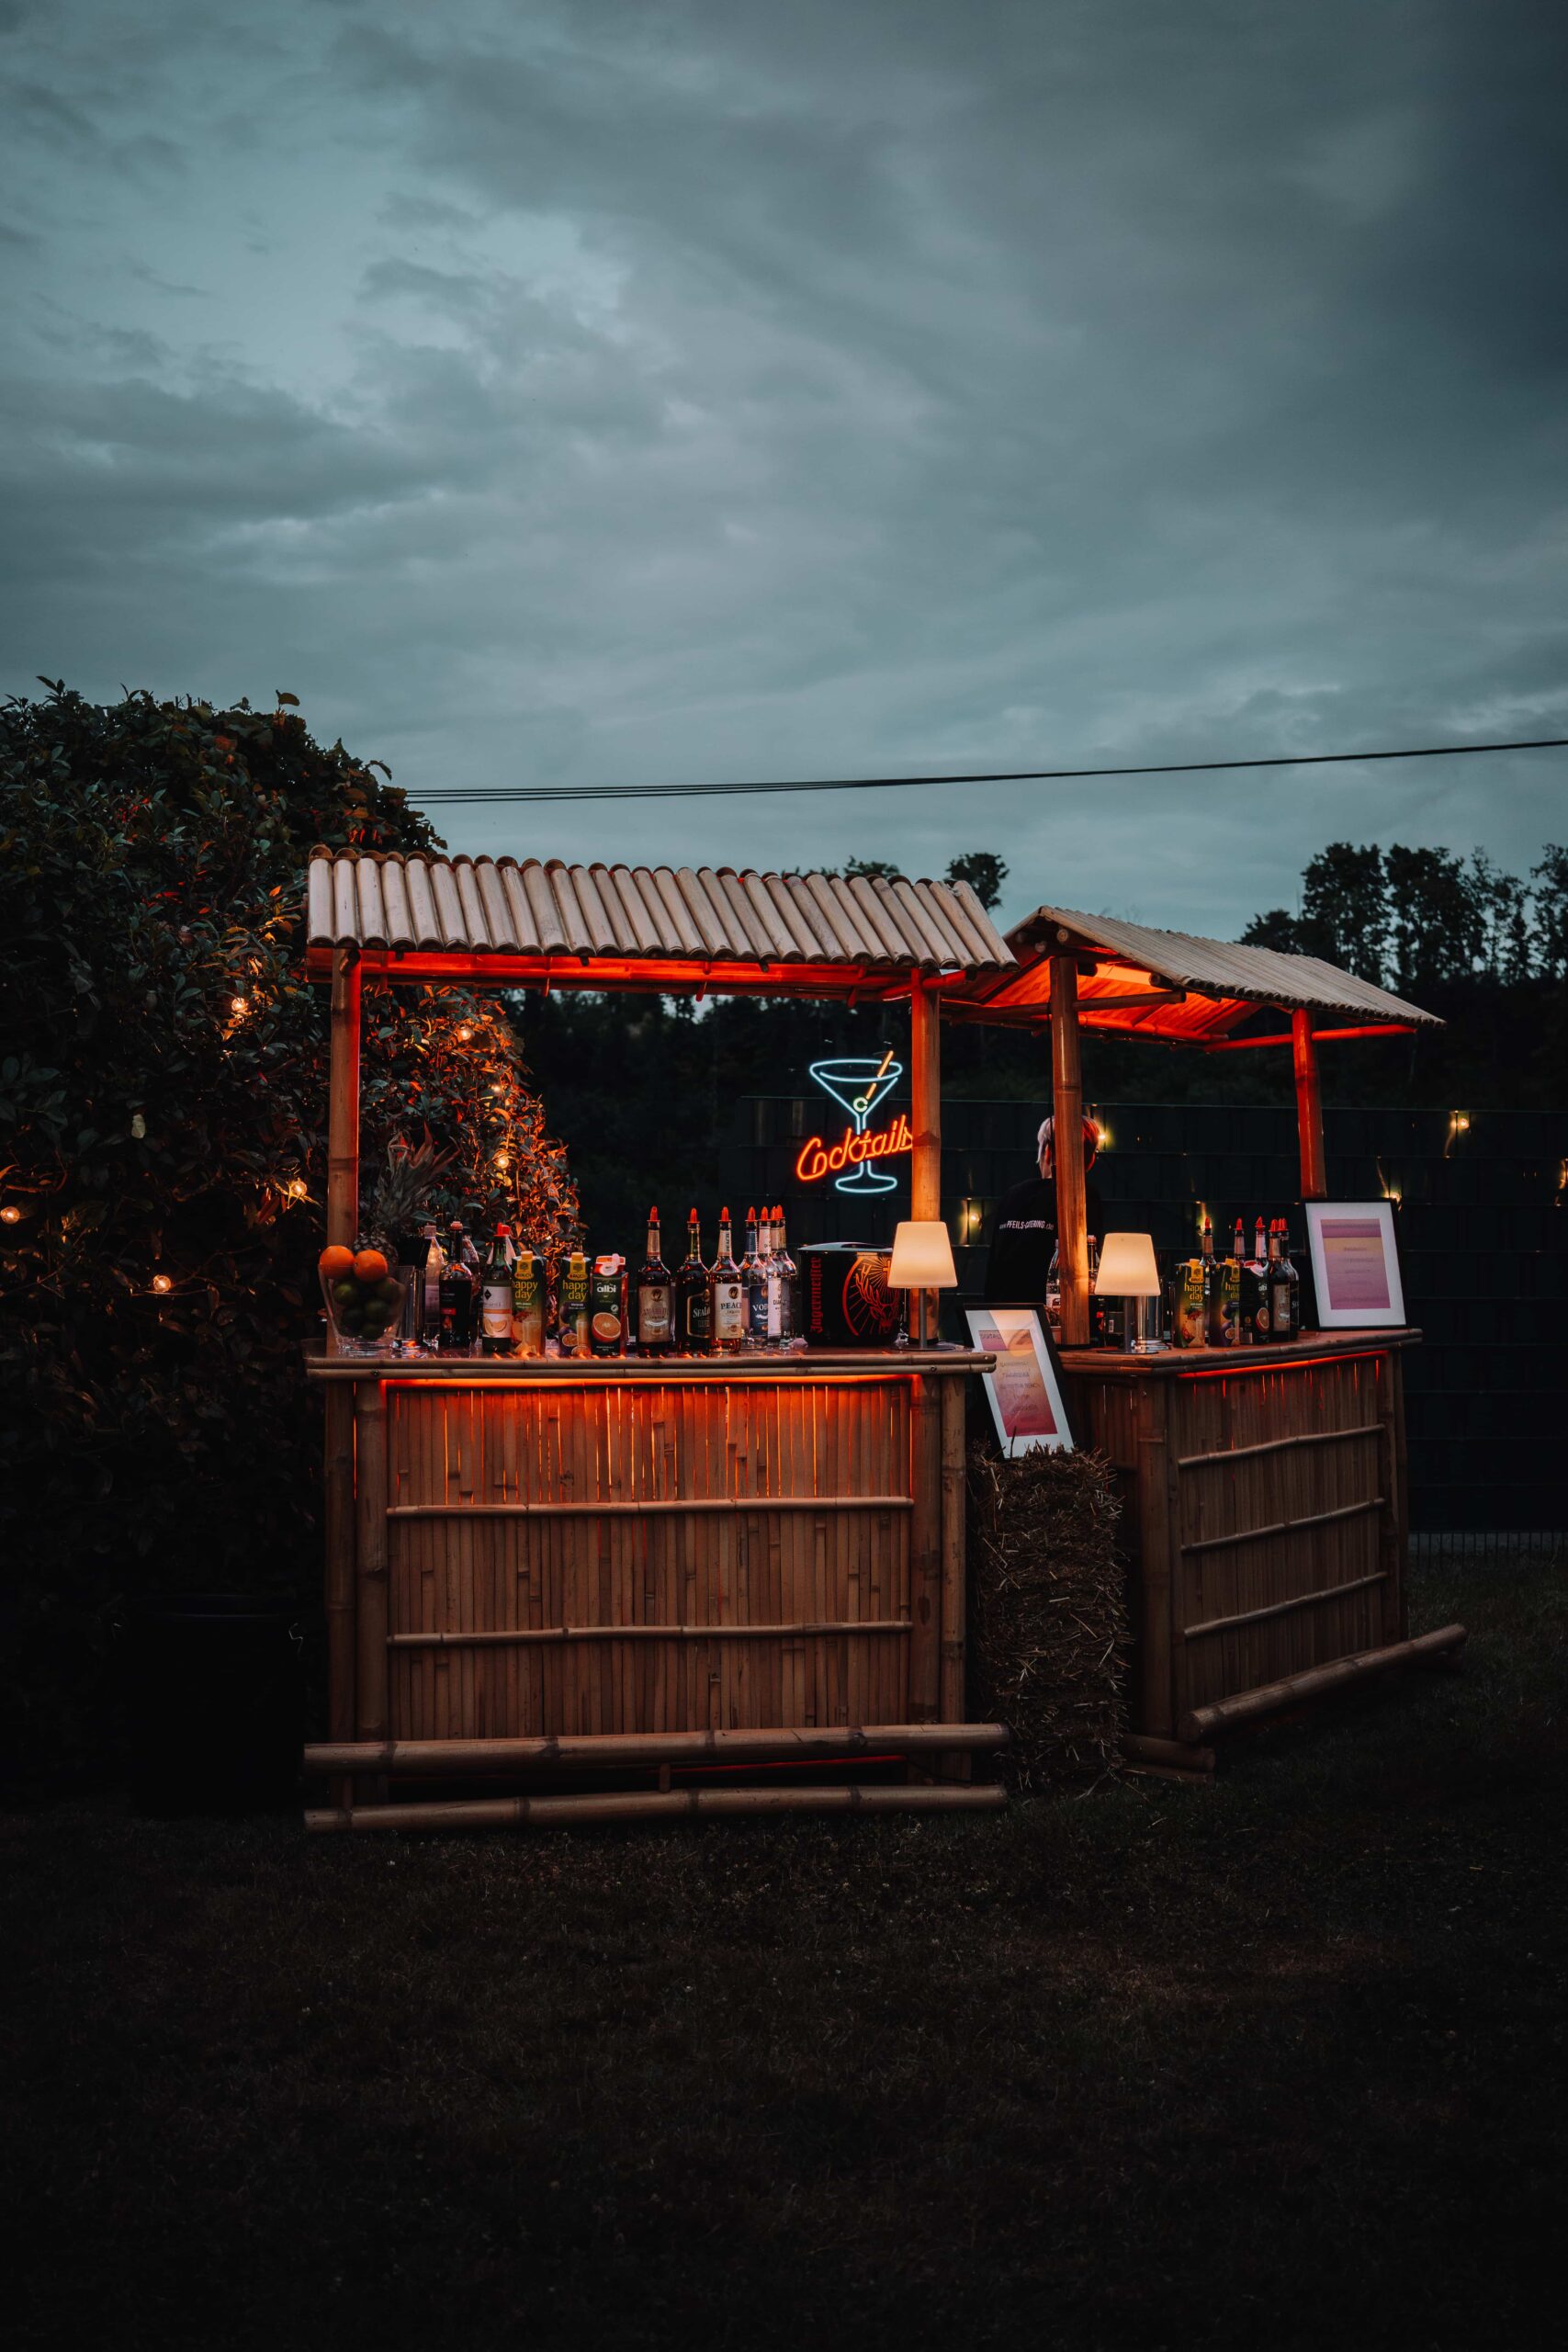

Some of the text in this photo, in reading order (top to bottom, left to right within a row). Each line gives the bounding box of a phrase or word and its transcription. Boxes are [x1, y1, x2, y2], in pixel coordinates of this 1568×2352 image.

[795, 1114, 913, 1182] Cocktails
[562, 1280, 587, 1292] happ
[596, 1284, 616, 1293] albi
[1184, 1283, 1204, 1294] happ
[514, 1289, 535, 1302] day
[568, 1289, 587, 1302] day
[1190, 1291, 1203, 1303] day
[720, 1302, 742, 1310] PEAC
